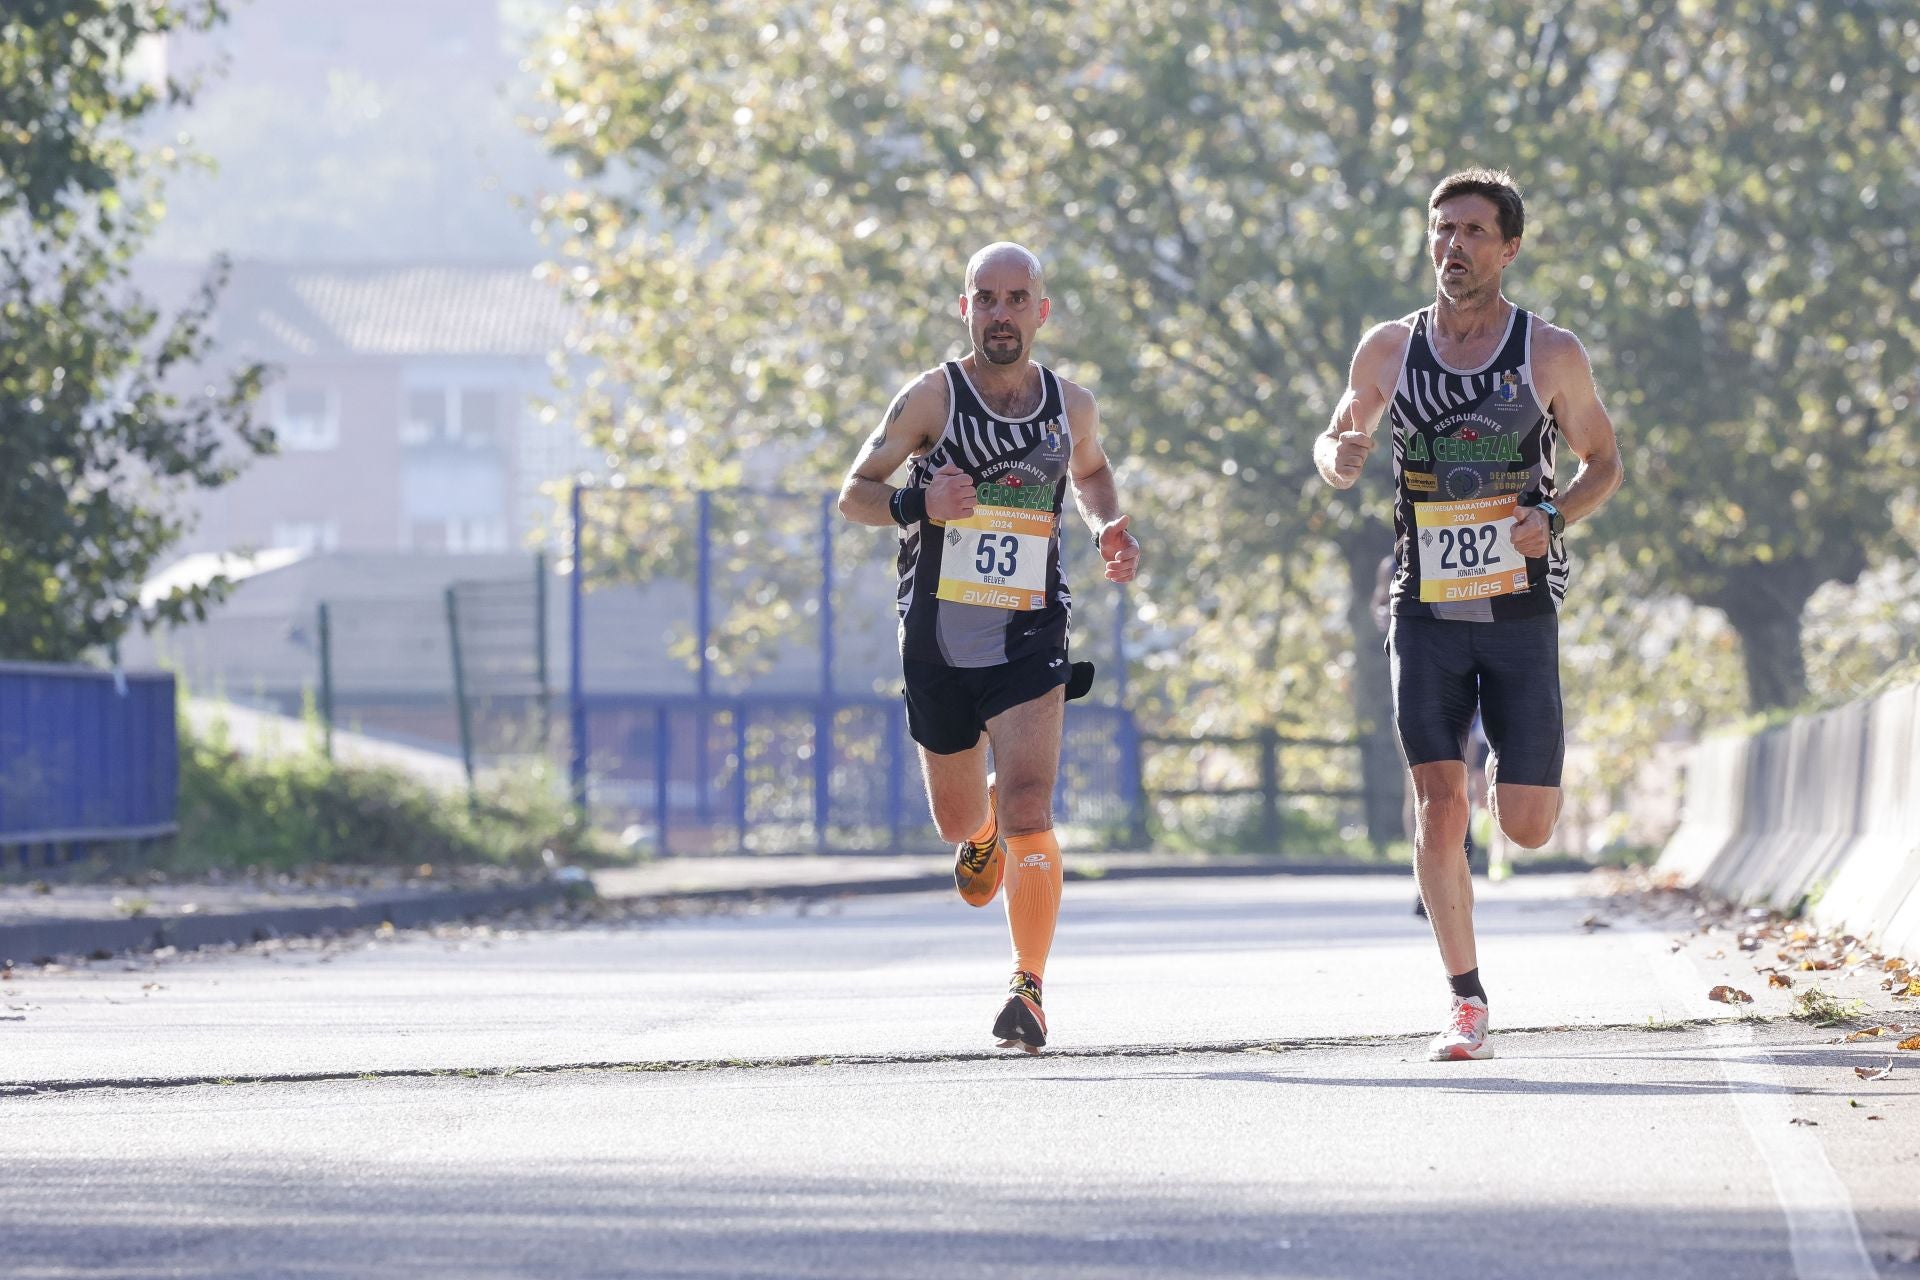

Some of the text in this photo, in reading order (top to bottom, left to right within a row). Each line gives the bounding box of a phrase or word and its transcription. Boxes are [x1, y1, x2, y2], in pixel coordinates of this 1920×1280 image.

[1433, 413, 1503, 433] RESTAURANTE
[1403, 427, 1523, 462] LA CEREZAL
[981, 460, 1048, 483] RESTAURANTE
[1489, 471, 1530, 480] DEPORTES
[1434, 504, 1454, 512] MEDIA
[1454, 501, 1492, 512] MARATÓN
[1492, 496, 1518, 507] AVILÉS
[974, 508, 1051, 523] MEDIA MARATÓN AVILÉS
[1453, 513, 1476, 522] 2024
[990, 520, 1012, 529] 2024
[976, 533, 1019, 577] 53
[1439, 524, 1501, 570] 282
[983, 575, 1006, 585] BELVER
[1457, 567, 1487, 578] JONATHAN
[1446, 580, 1502, 599] avilés
[962, 589, 1021, 608] avilés
